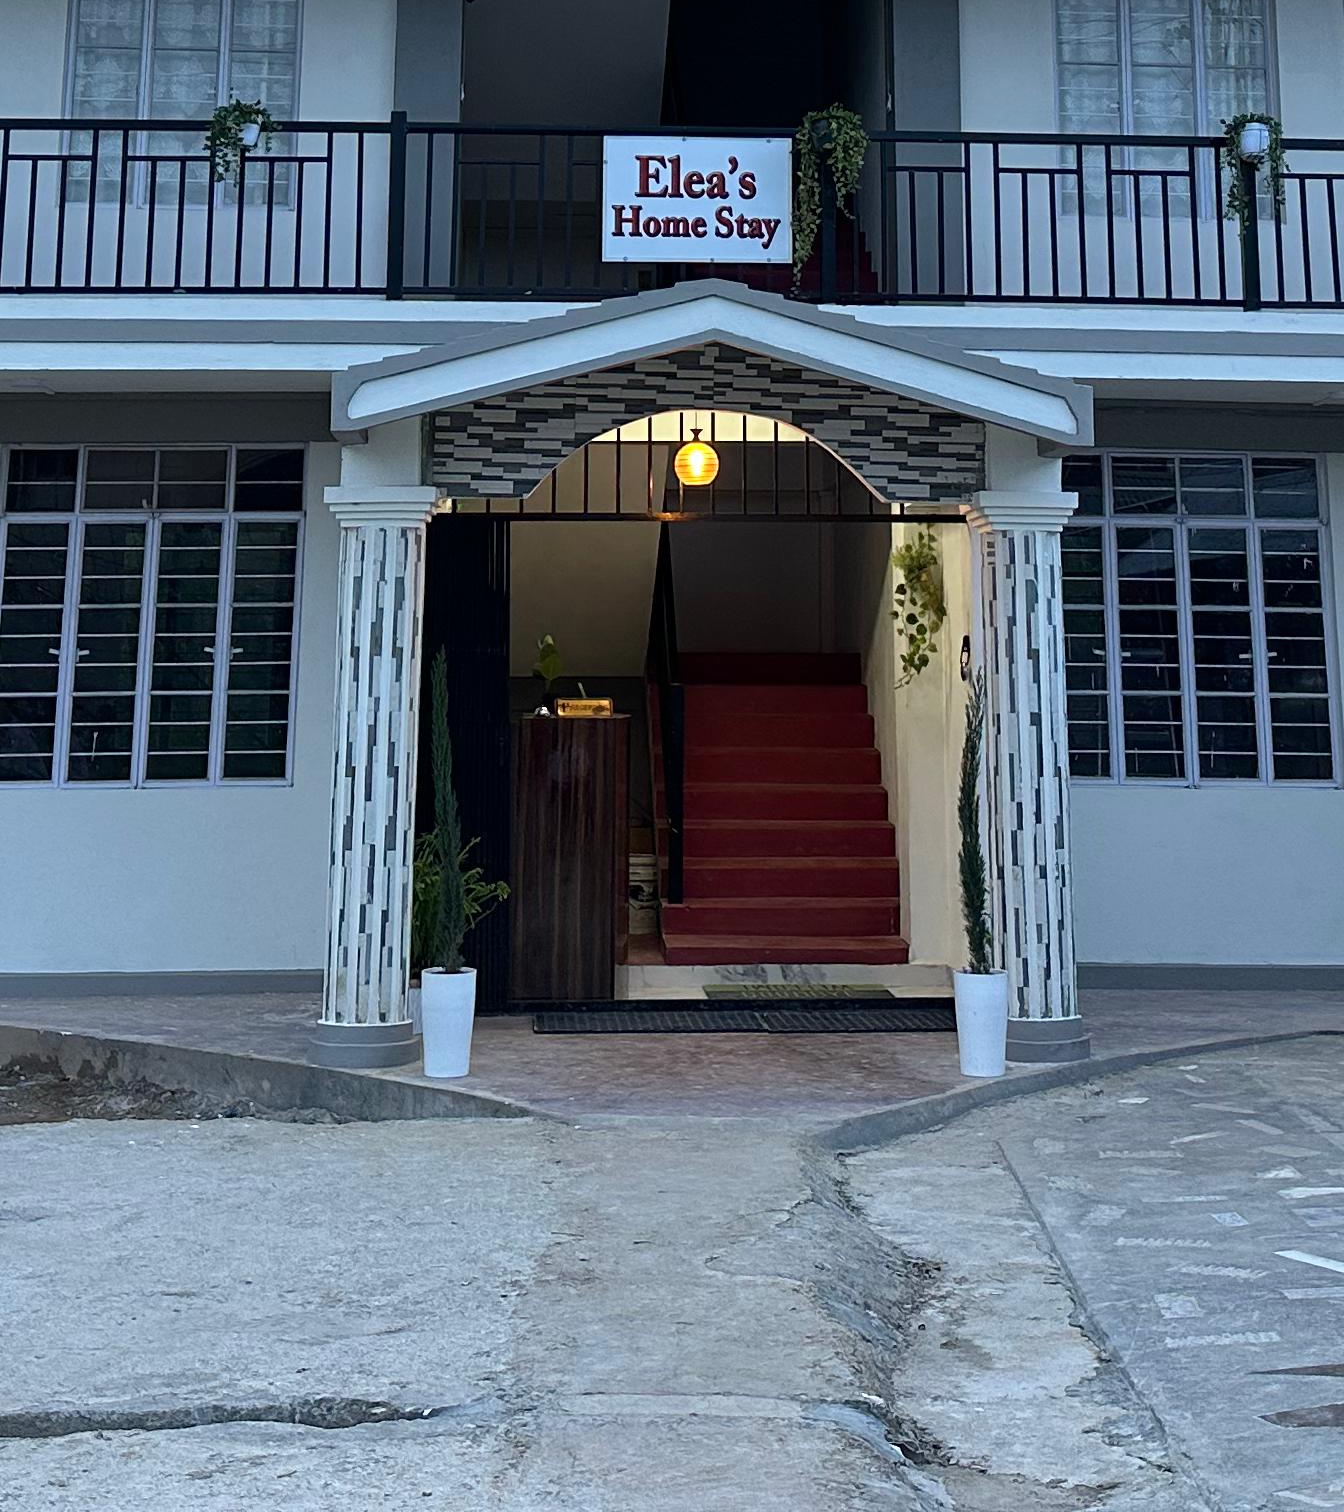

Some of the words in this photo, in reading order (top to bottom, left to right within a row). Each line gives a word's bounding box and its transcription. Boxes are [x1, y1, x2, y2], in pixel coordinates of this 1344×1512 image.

[635, 155, 757, 199] Elea's
[612, 205, 706, 238] Home
[715, 206, 781, 249] Stay
